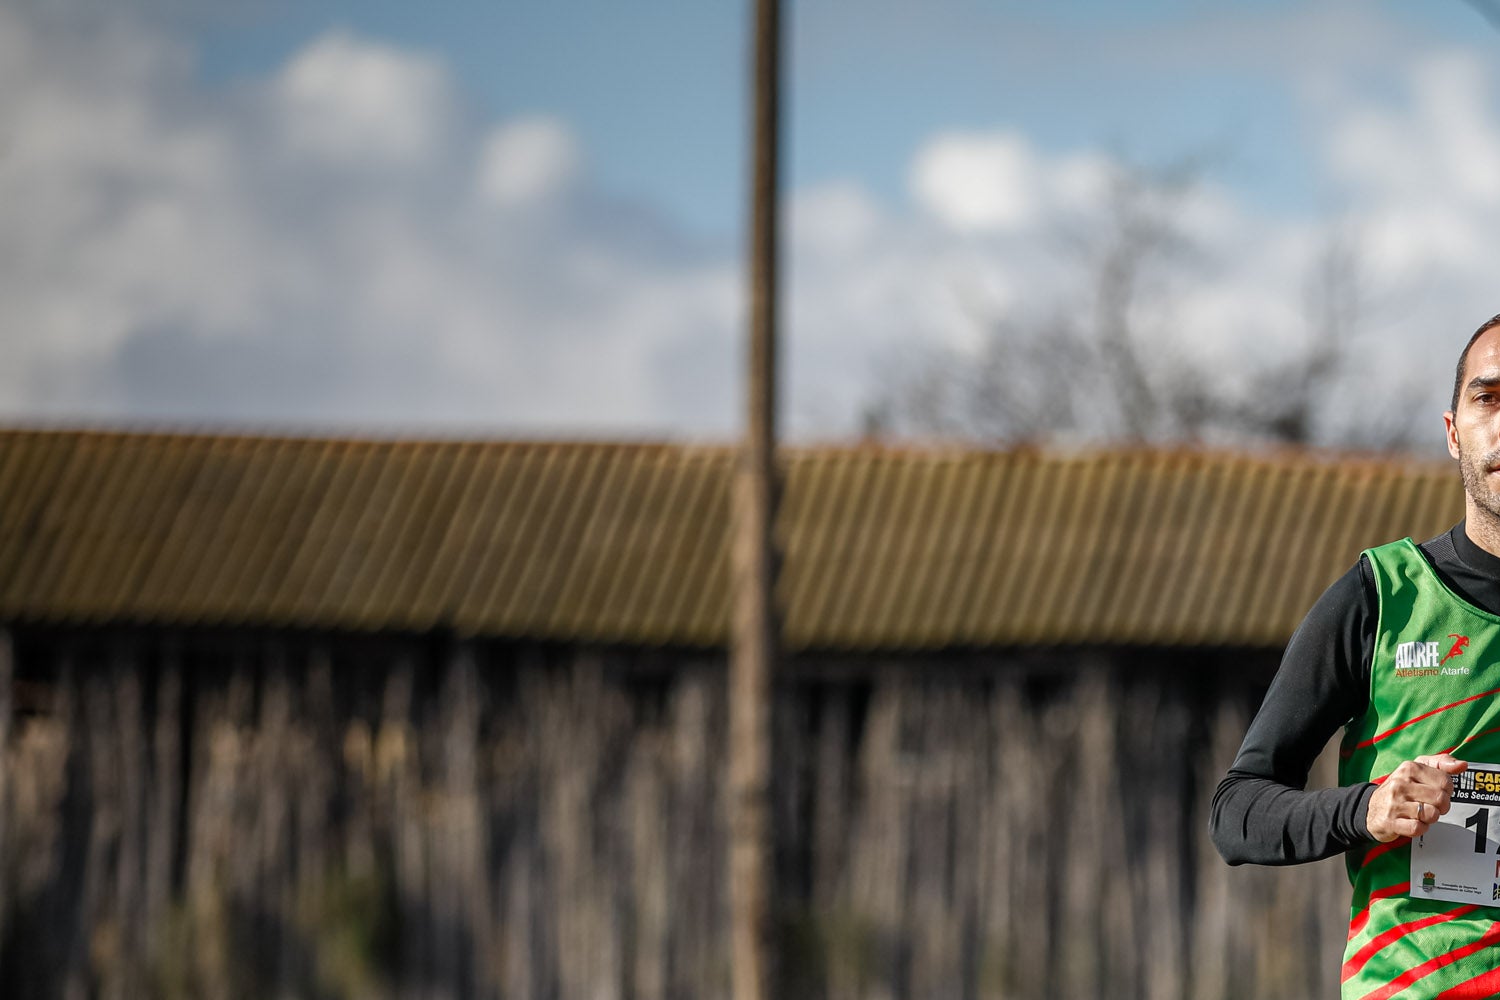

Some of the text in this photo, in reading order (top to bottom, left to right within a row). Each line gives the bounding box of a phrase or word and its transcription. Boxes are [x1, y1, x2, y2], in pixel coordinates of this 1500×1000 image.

[1395, 641, 1440, 669] ATARFE
[1396, 666, 1470, 677] Atletismo Atarfe
[1457, 790, 1469, 799] los
